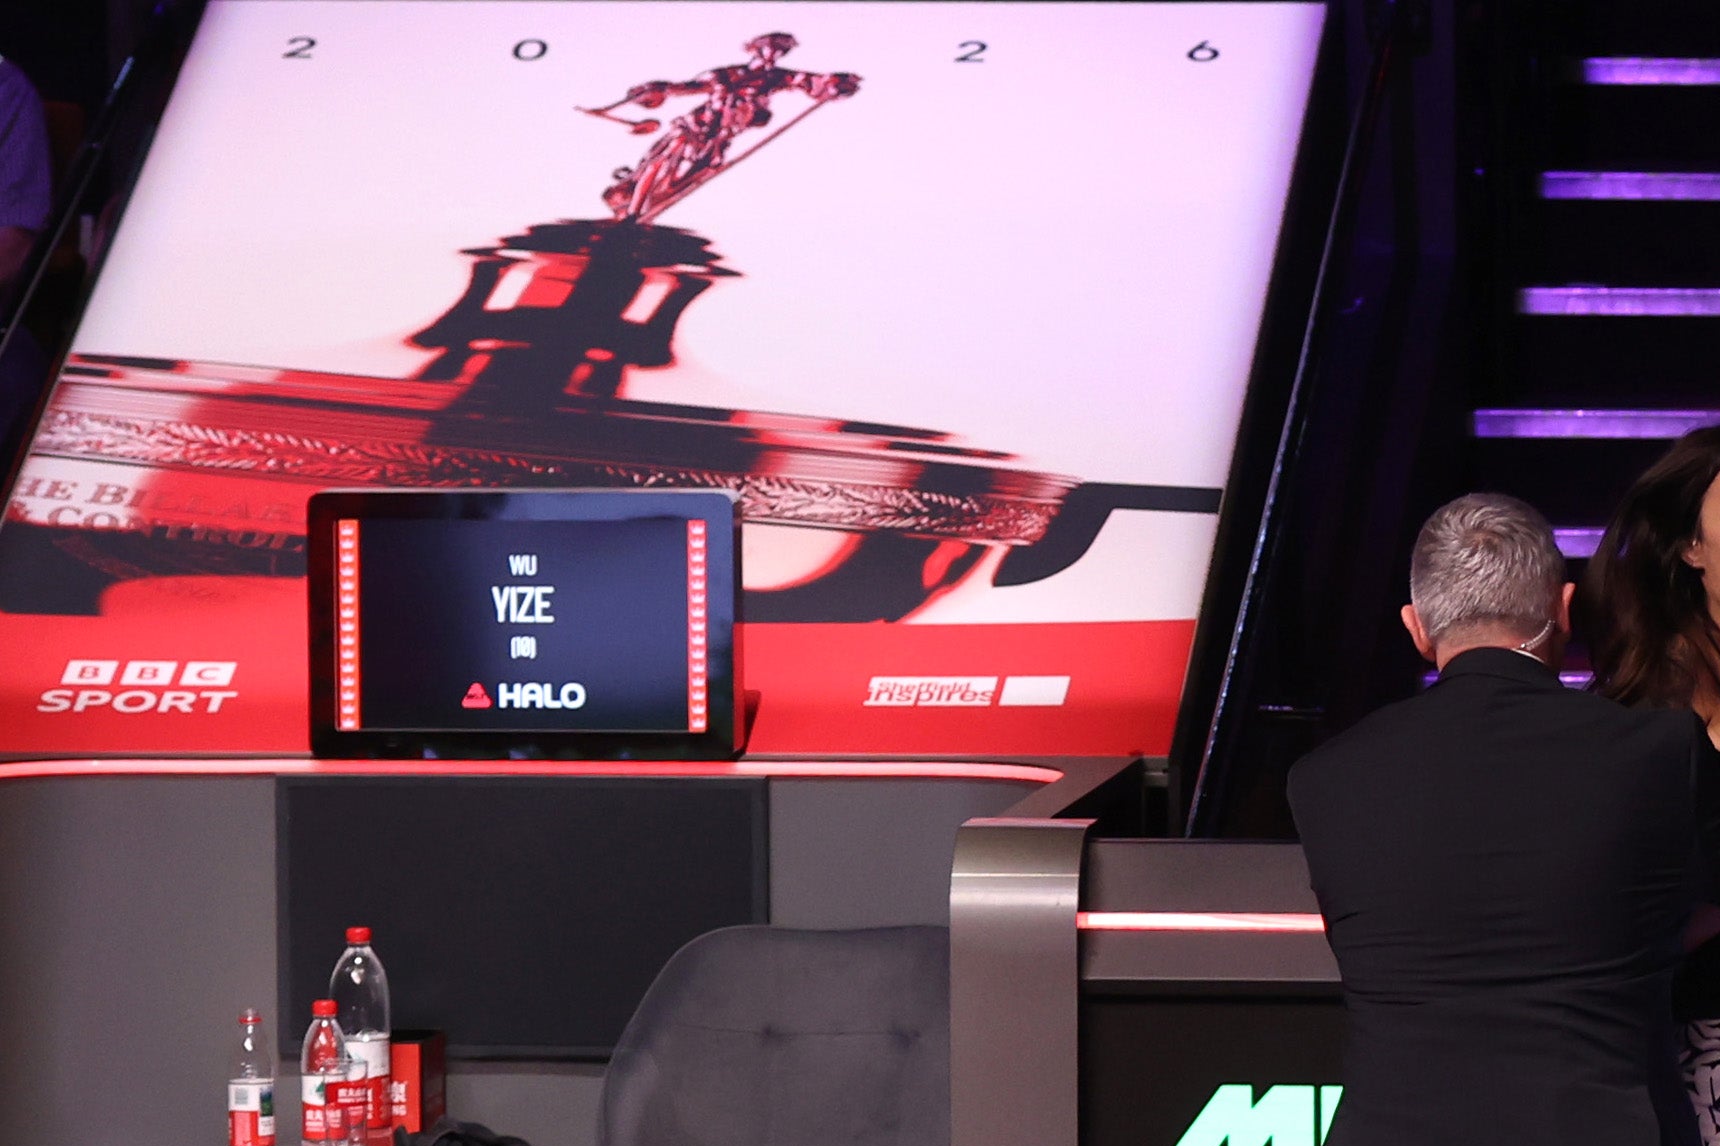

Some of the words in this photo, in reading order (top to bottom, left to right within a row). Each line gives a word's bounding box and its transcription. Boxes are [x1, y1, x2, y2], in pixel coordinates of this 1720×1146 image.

[282, 37, 317, 59] 2
[512, 39, 549, 61] 0
[955, 41, 988, 63] 2
[1186, 40, 1221, 62] 6
[508, 554, 538, 576] WU
[491, 585, 556, 624] YIZE
[510, 635, 537, 660] (10)
[69, 662, 229, 684] BBC
[36, 689, 239, 714] SPORT
[498, 682, 587, 709] HALO
